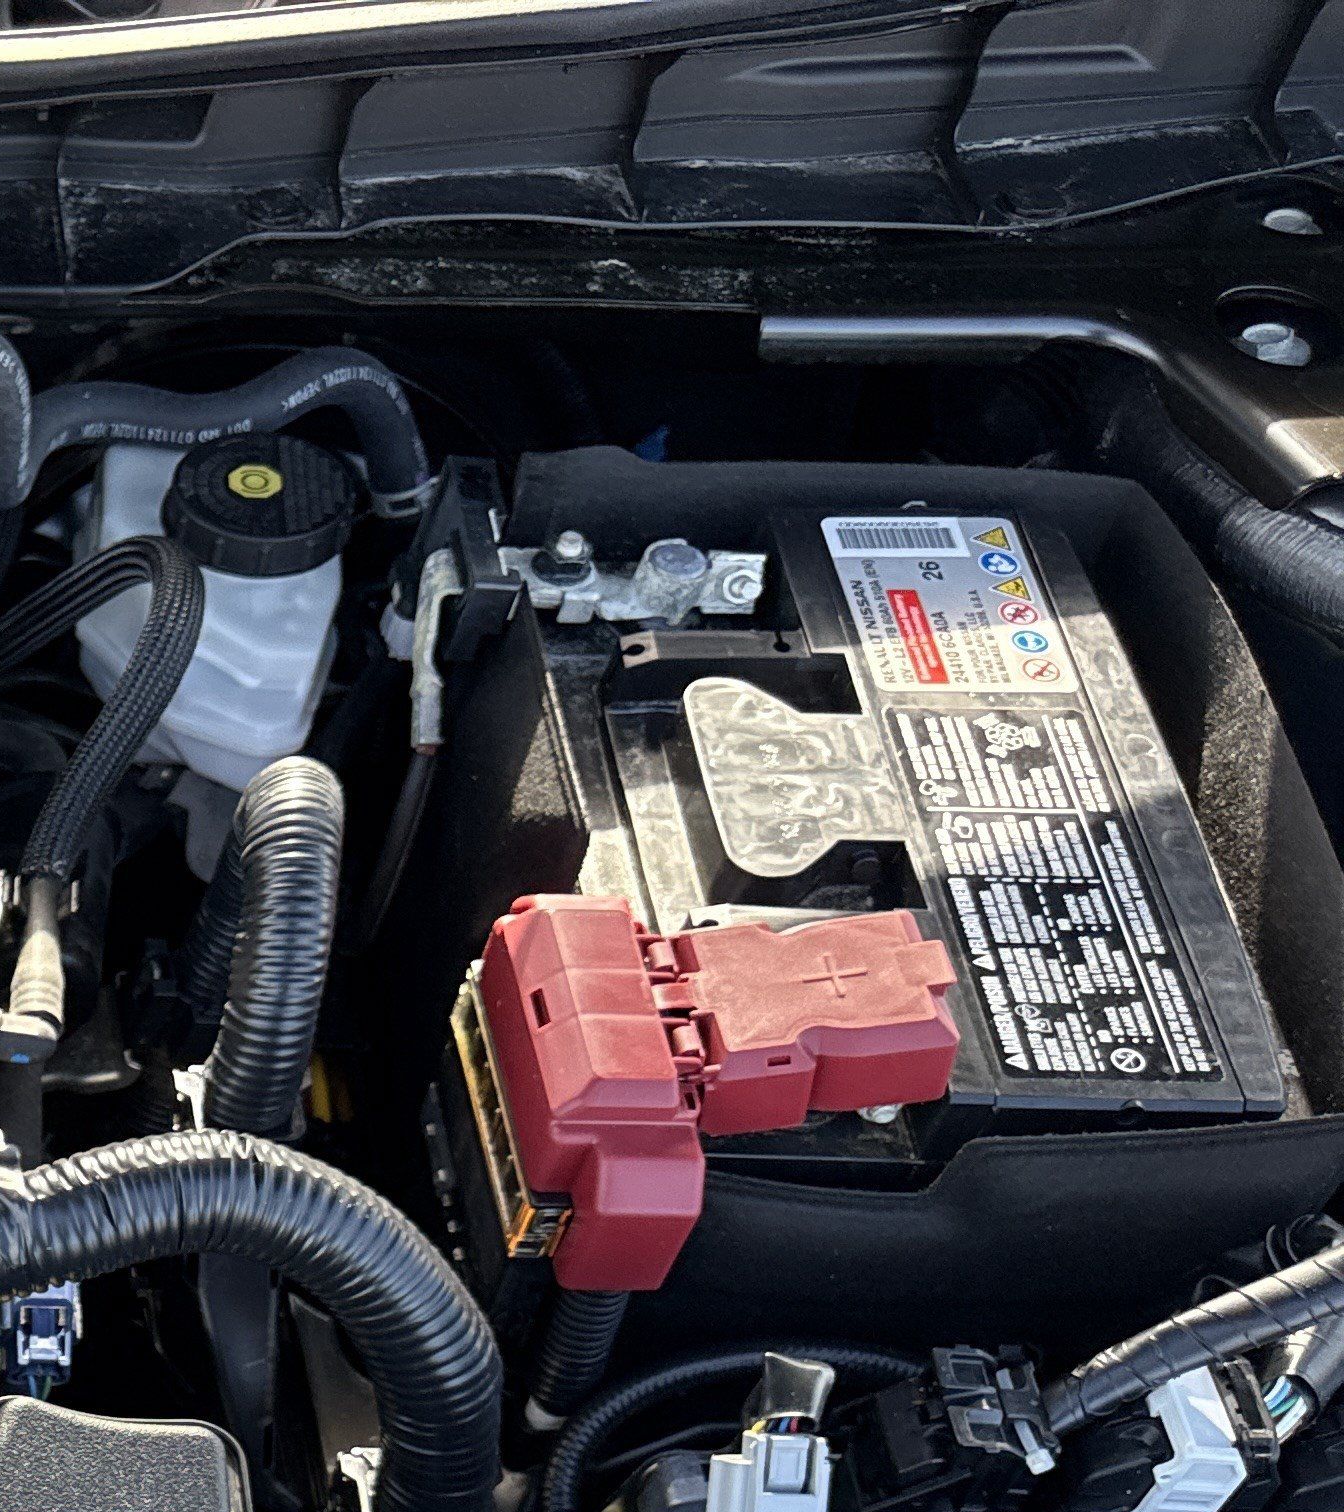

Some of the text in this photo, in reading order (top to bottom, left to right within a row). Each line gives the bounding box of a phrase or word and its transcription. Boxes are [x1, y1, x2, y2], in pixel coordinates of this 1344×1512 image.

[915, 560, 944, 581] 26
[848, 578, 878, 630] NISSAN
[943, 651, 969, 683] 24410
